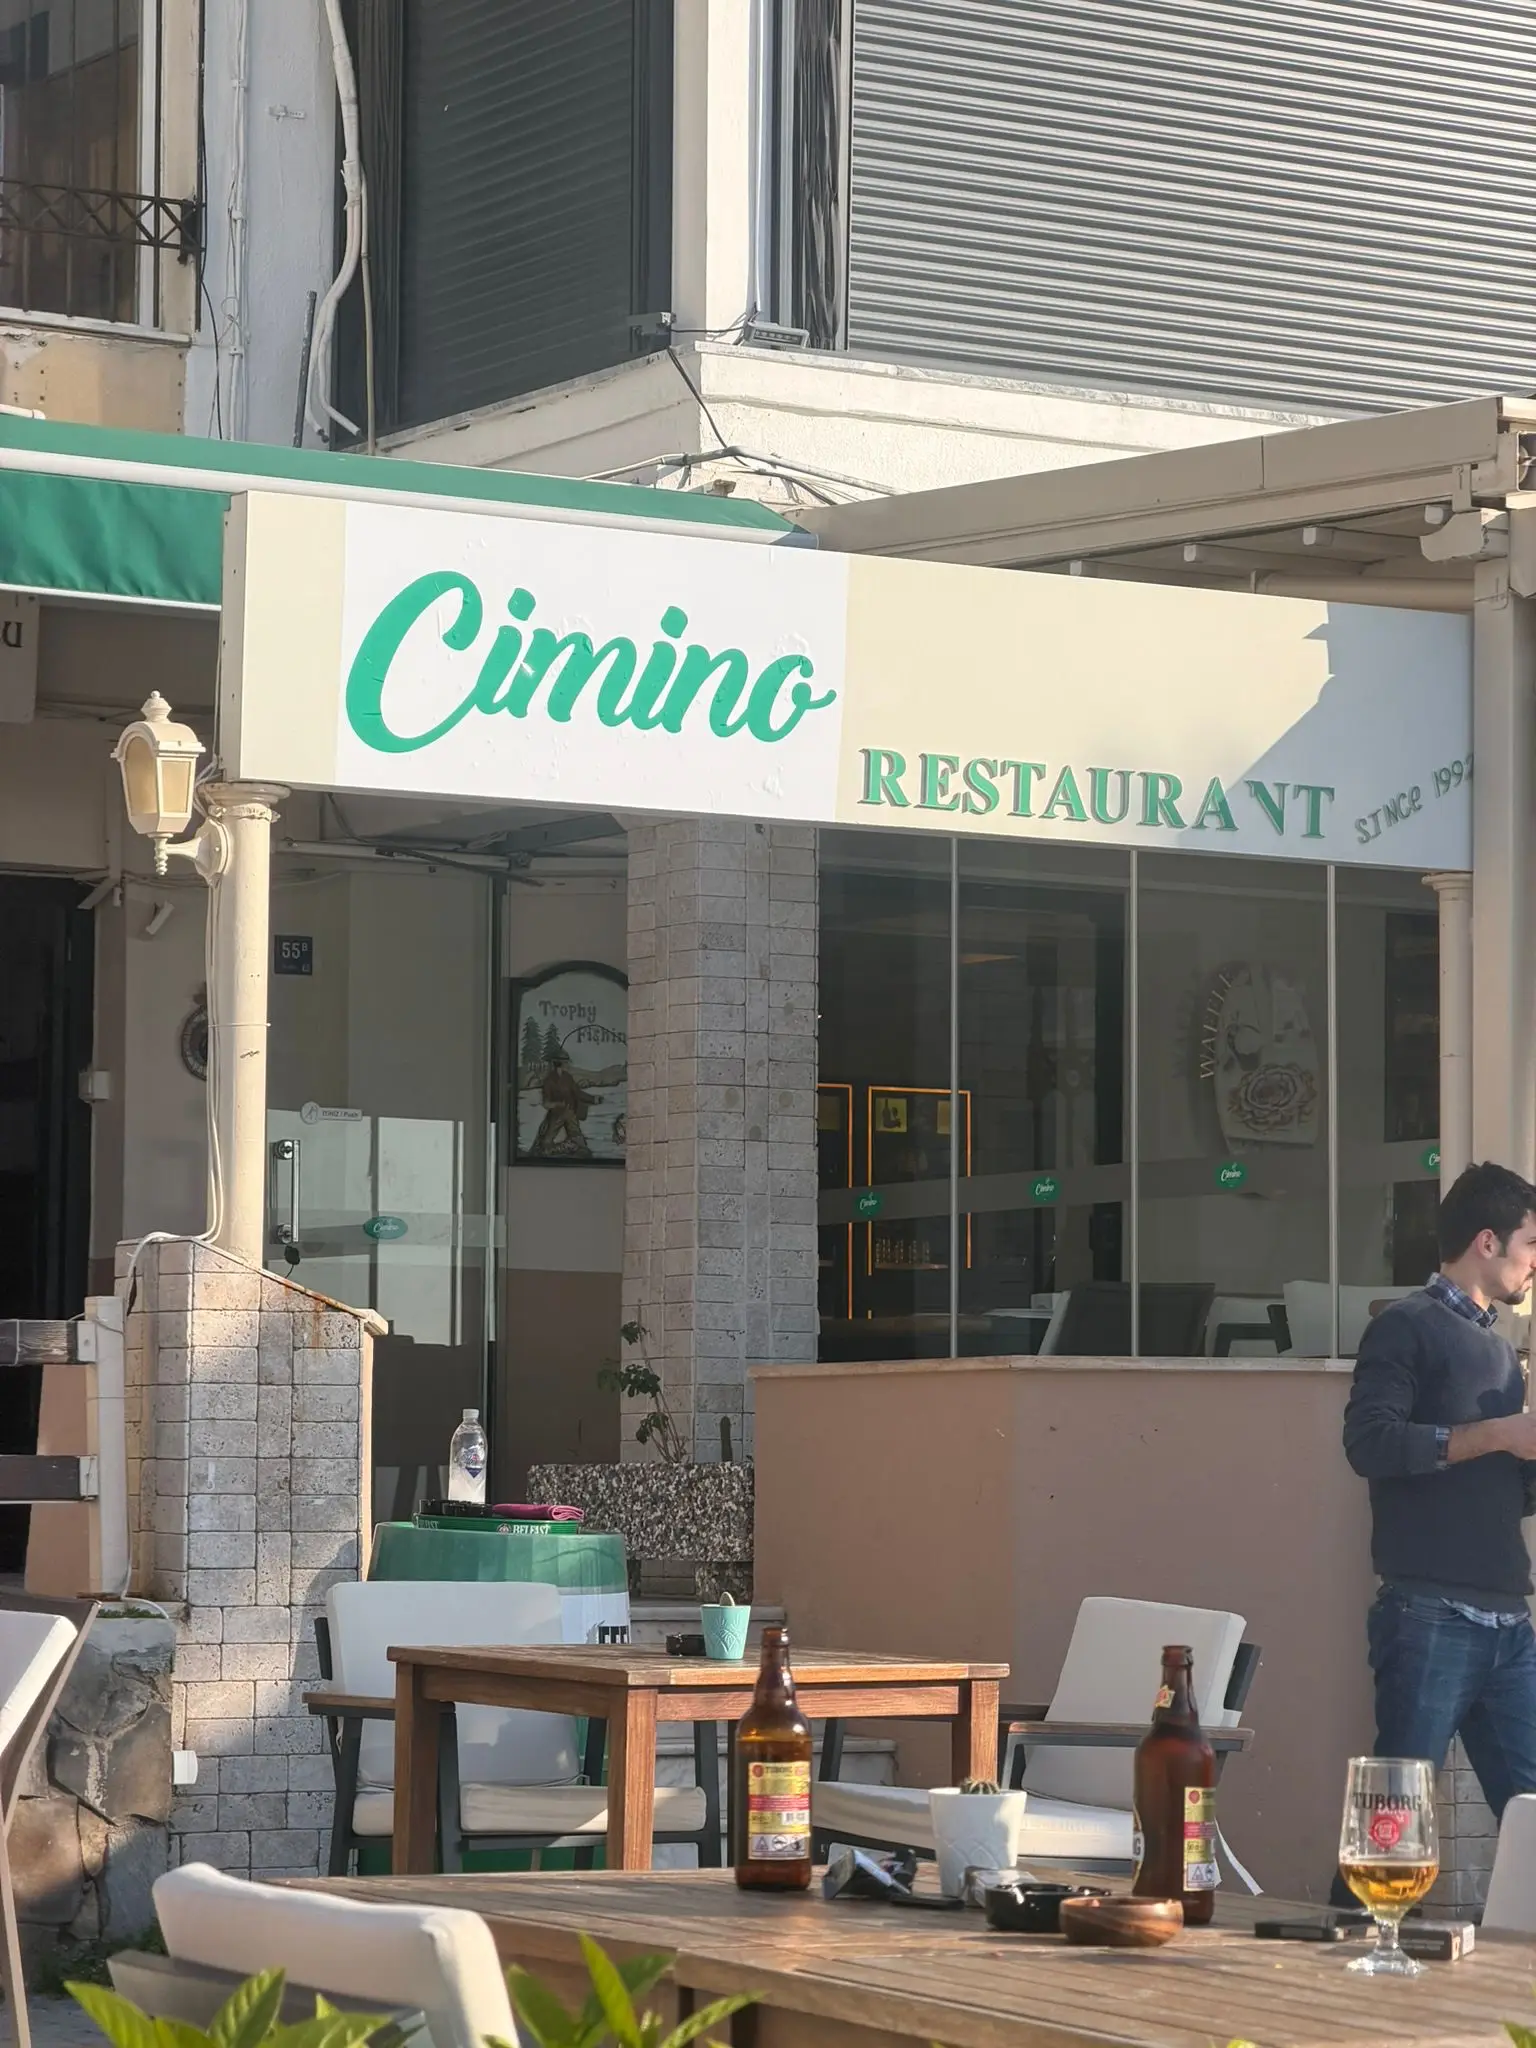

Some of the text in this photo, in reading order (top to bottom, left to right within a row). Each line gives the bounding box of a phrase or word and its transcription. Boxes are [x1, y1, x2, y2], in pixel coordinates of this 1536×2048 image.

[346, 571, 837, 753] Cimino
[858, 747, 1335, 839] RESTAURANT
[538, 1000, 597, 1024] Trophy
[513, 1525, 549, 1535] BELFAST
[1352, 1792, 1422, 1812] TUBORG
